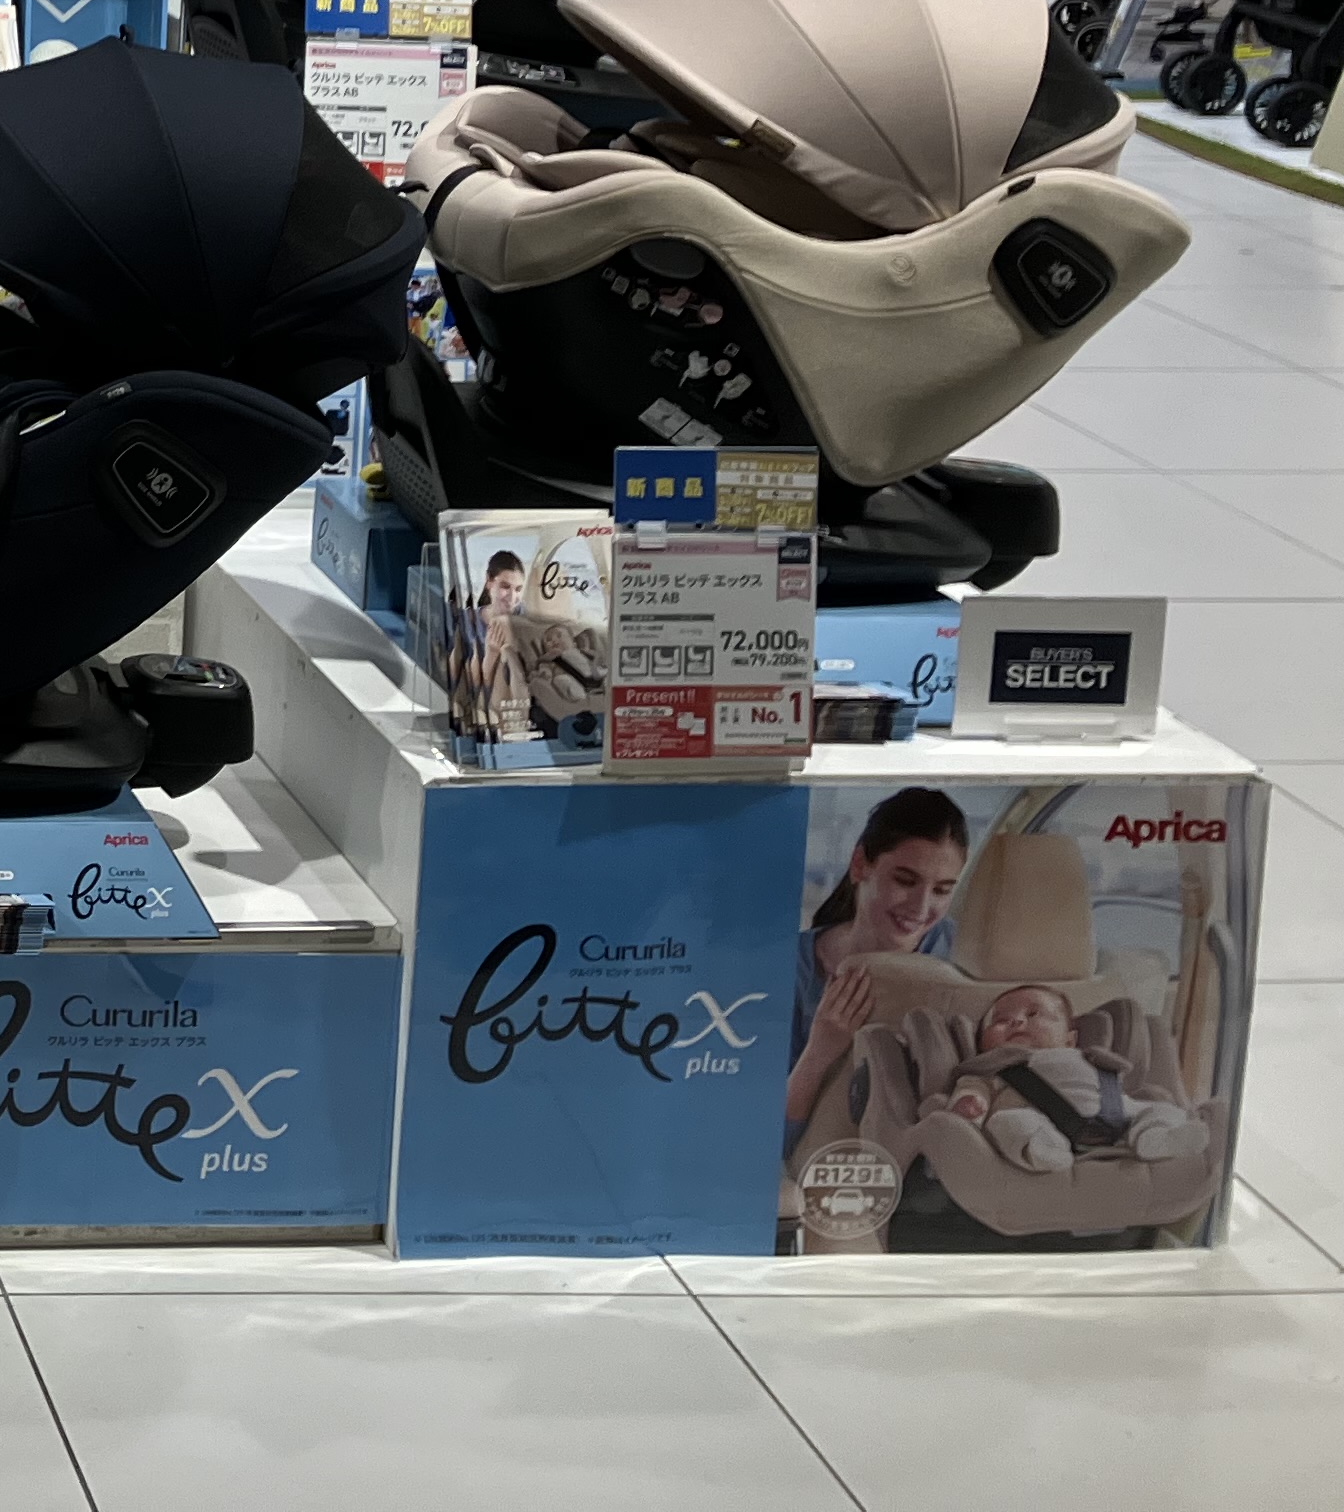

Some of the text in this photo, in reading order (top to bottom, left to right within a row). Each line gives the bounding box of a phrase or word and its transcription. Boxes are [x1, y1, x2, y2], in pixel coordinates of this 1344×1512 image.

[720, 629, 809, 653] 72,000円
[1005, 664, 1114, 690] SELECT
[102, 832, 147, 849] Aprica
[1104, 814, 1228, 850] Aprica
[579, 934, 687, 964] Cururila
[60, 993, 199, 1030] Cururila
[47, 1036, 89, 1049] クルリラ
[128, 1036, 171, 1049] エックス
[175, 1036, 208, 1049] プラス
[684, 1052, 742, 1081] plus
[200, 1145, 269, 1180] plus
